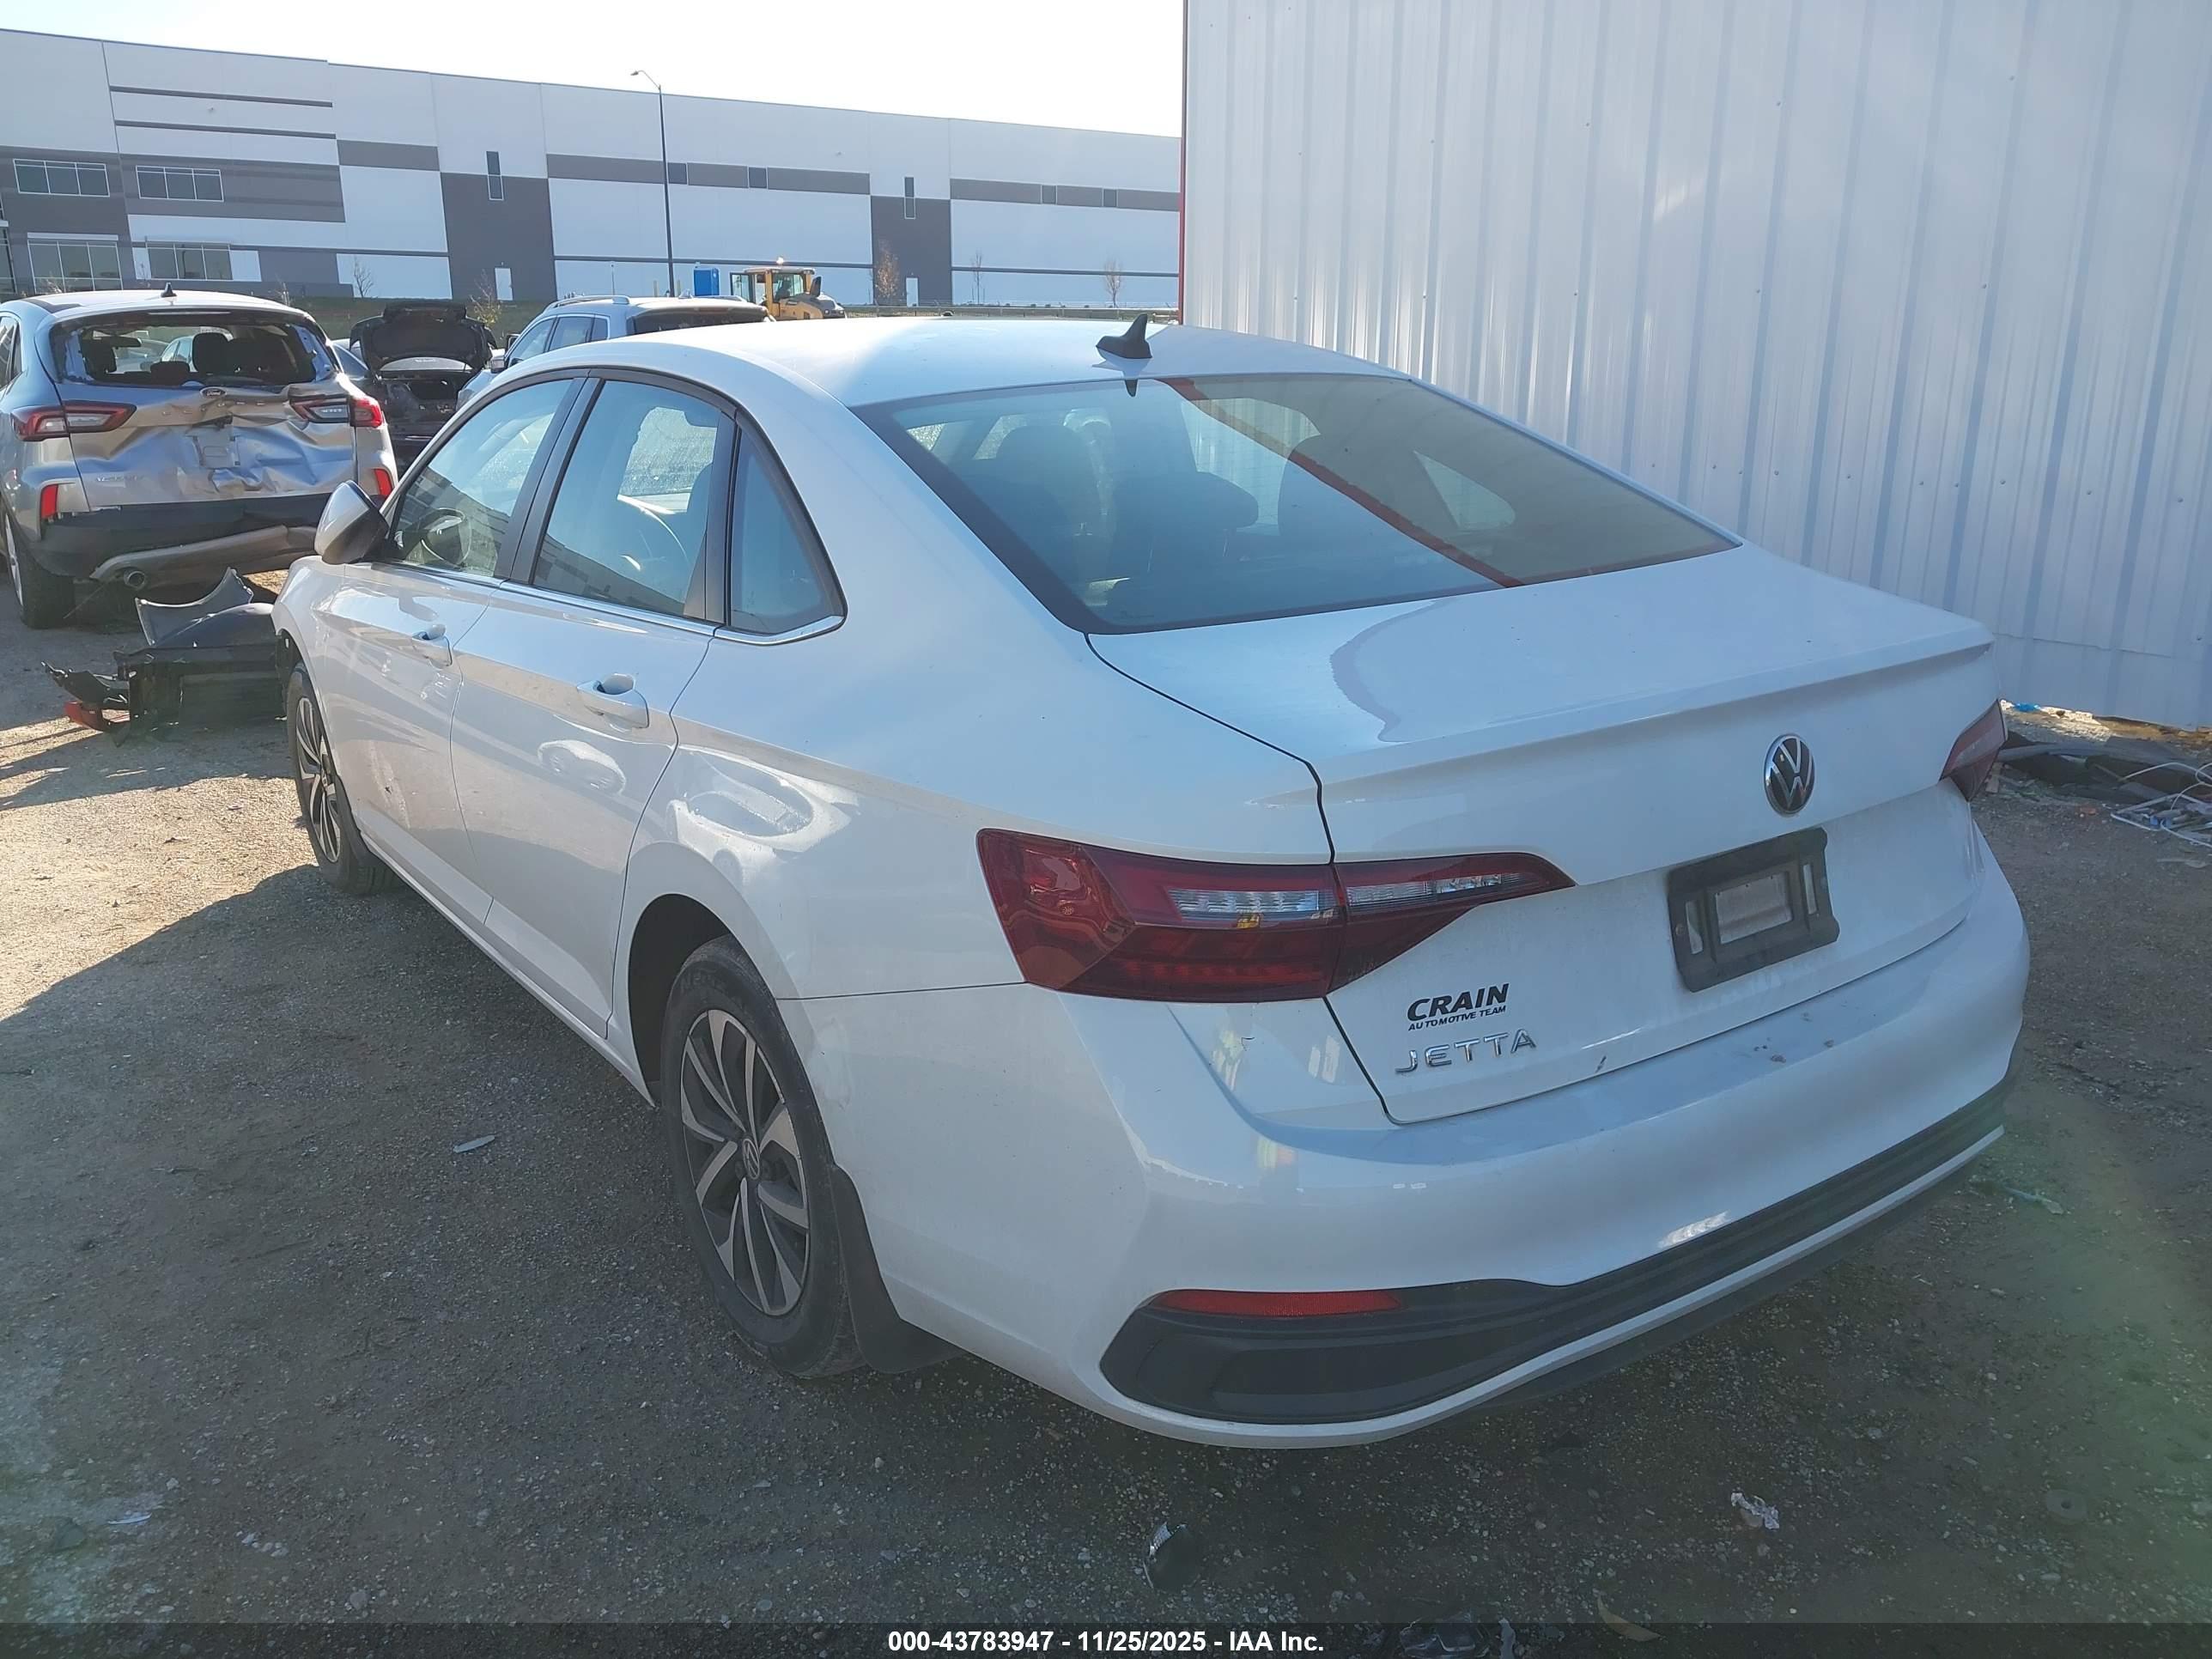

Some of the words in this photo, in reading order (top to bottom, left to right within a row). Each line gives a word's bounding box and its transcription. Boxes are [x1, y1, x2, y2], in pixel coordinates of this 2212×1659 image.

[1407, 983, 1510, 1022] CRAIN
[1407, 1011, 1476, 1030] AUTOMOTIVE
[1480, 1006, 1506, 1018] TEAM
[1395, 1029, 1536, 1074] JETTA
